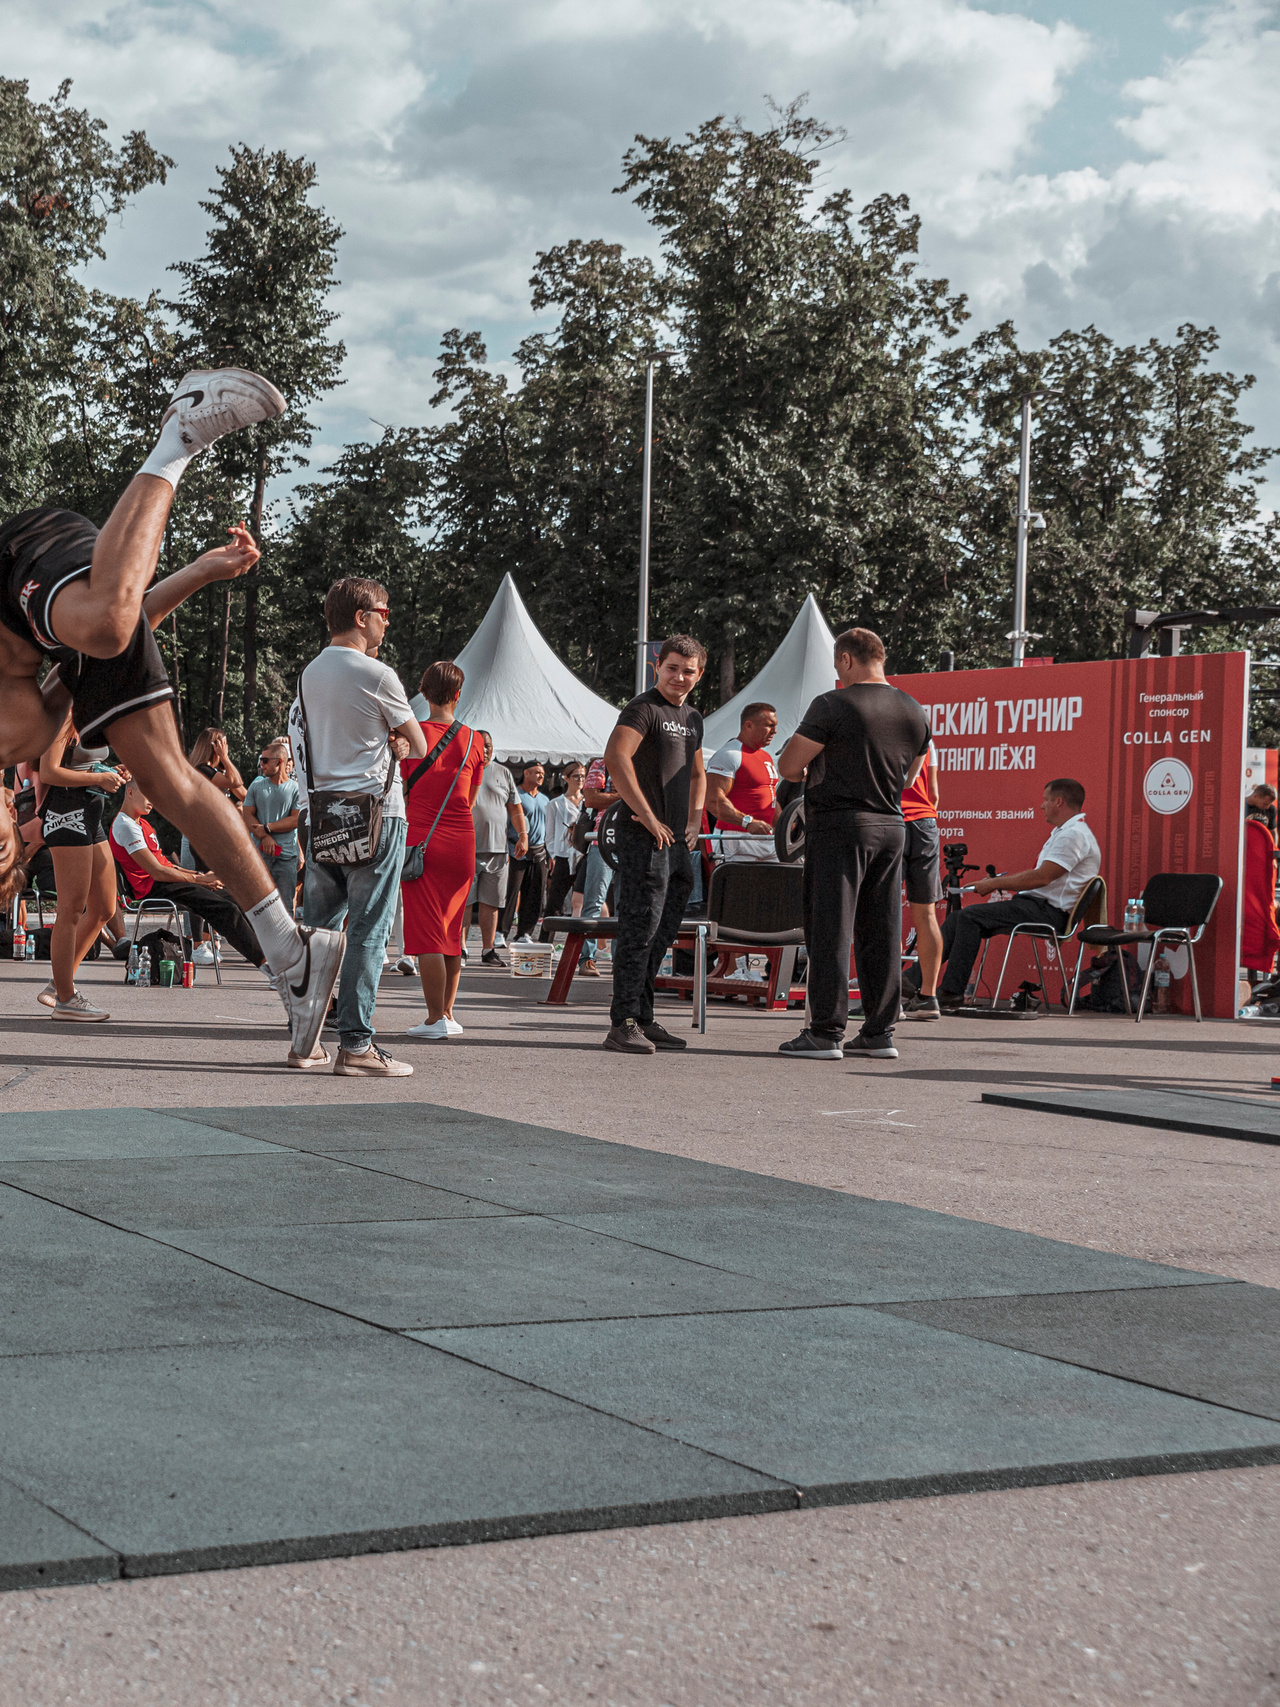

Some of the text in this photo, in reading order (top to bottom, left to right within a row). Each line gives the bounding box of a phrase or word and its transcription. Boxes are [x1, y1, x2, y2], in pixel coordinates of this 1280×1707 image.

[1139, 690, 1204, 704] Генеральный
[994, 696, 1082, 734] ТУРНИР
[1149, 708, 1189, 718] спонсор
[1123, 729, 1211, 744] COLLA GEN
[988, 743, 1036, 770] ЛЁЖА
[995, 807, 1035, 819] званий
[314, 832, 349, 849] SWEDEN
[606, 828, 616, 844] 20
